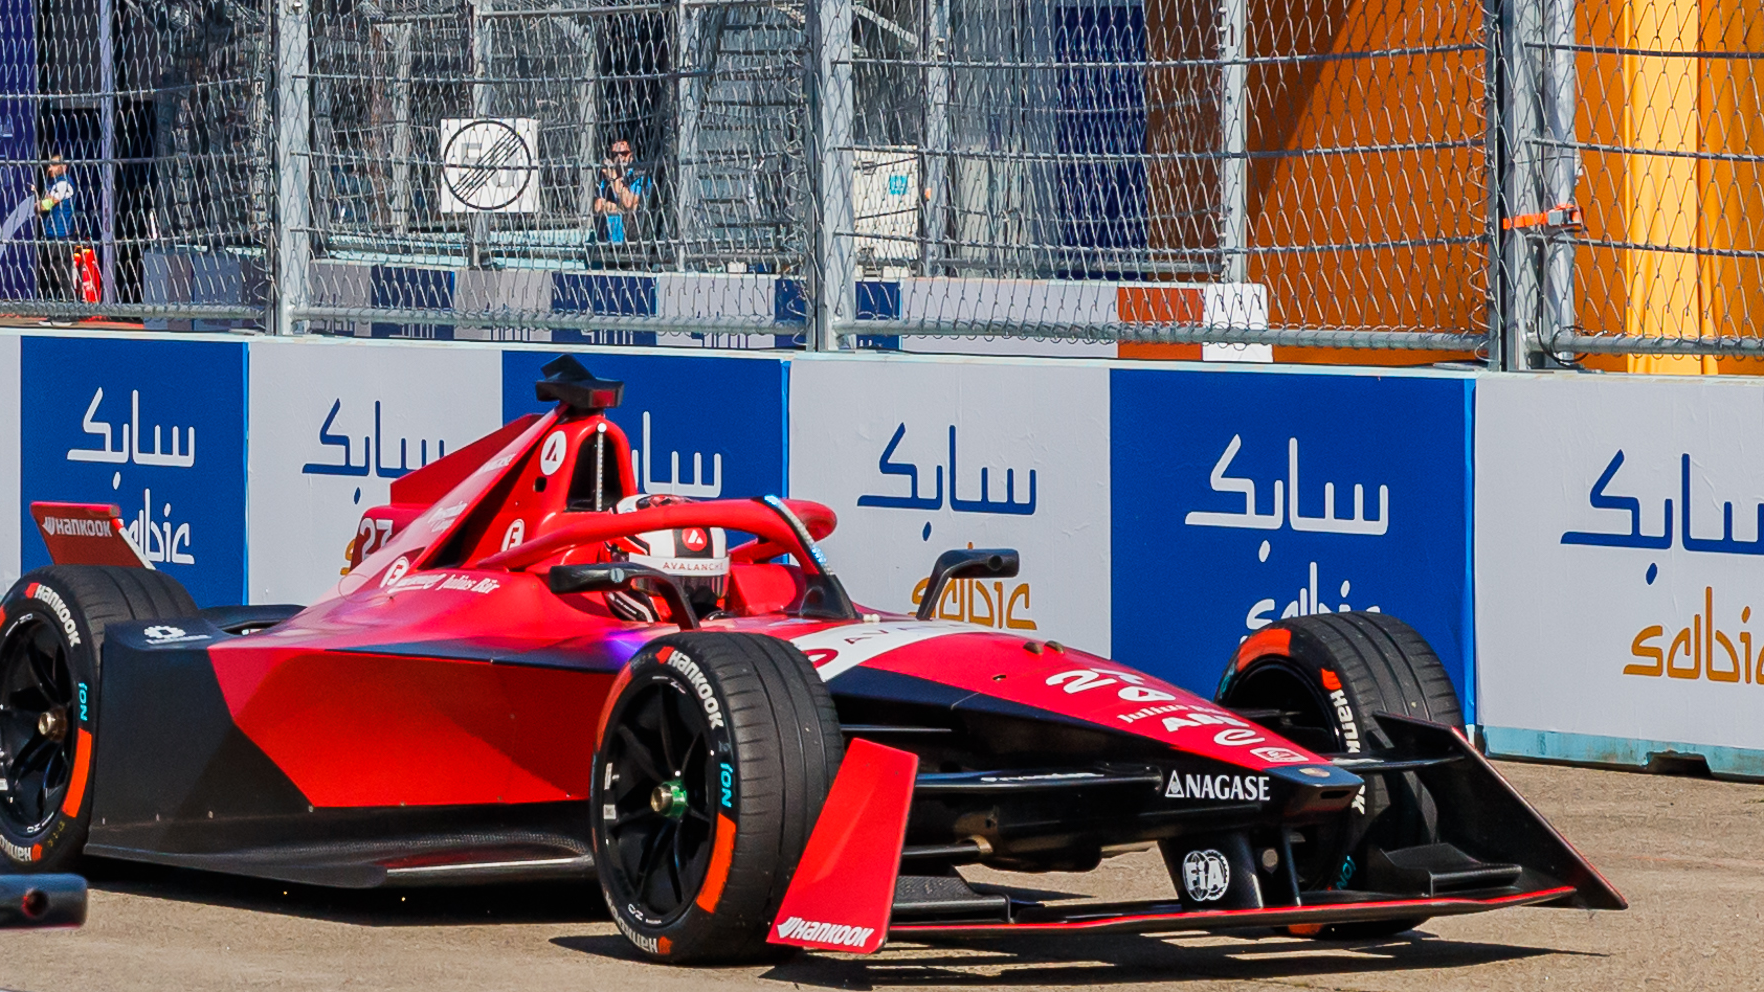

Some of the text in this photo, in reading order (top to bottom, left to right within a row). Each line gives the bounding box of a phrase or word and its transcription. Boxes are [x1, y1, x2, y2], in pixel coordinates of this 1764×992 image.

[67, 386, 195, 490] سابك
[856, 421, 1037, 542] سابك
[119, 488, 196, 565] abic
[1185, 433, 1390, 563] سابك
[1185, 774, 1271, 802] NAGASE
[1186, 859, 1226, 890] FIA
